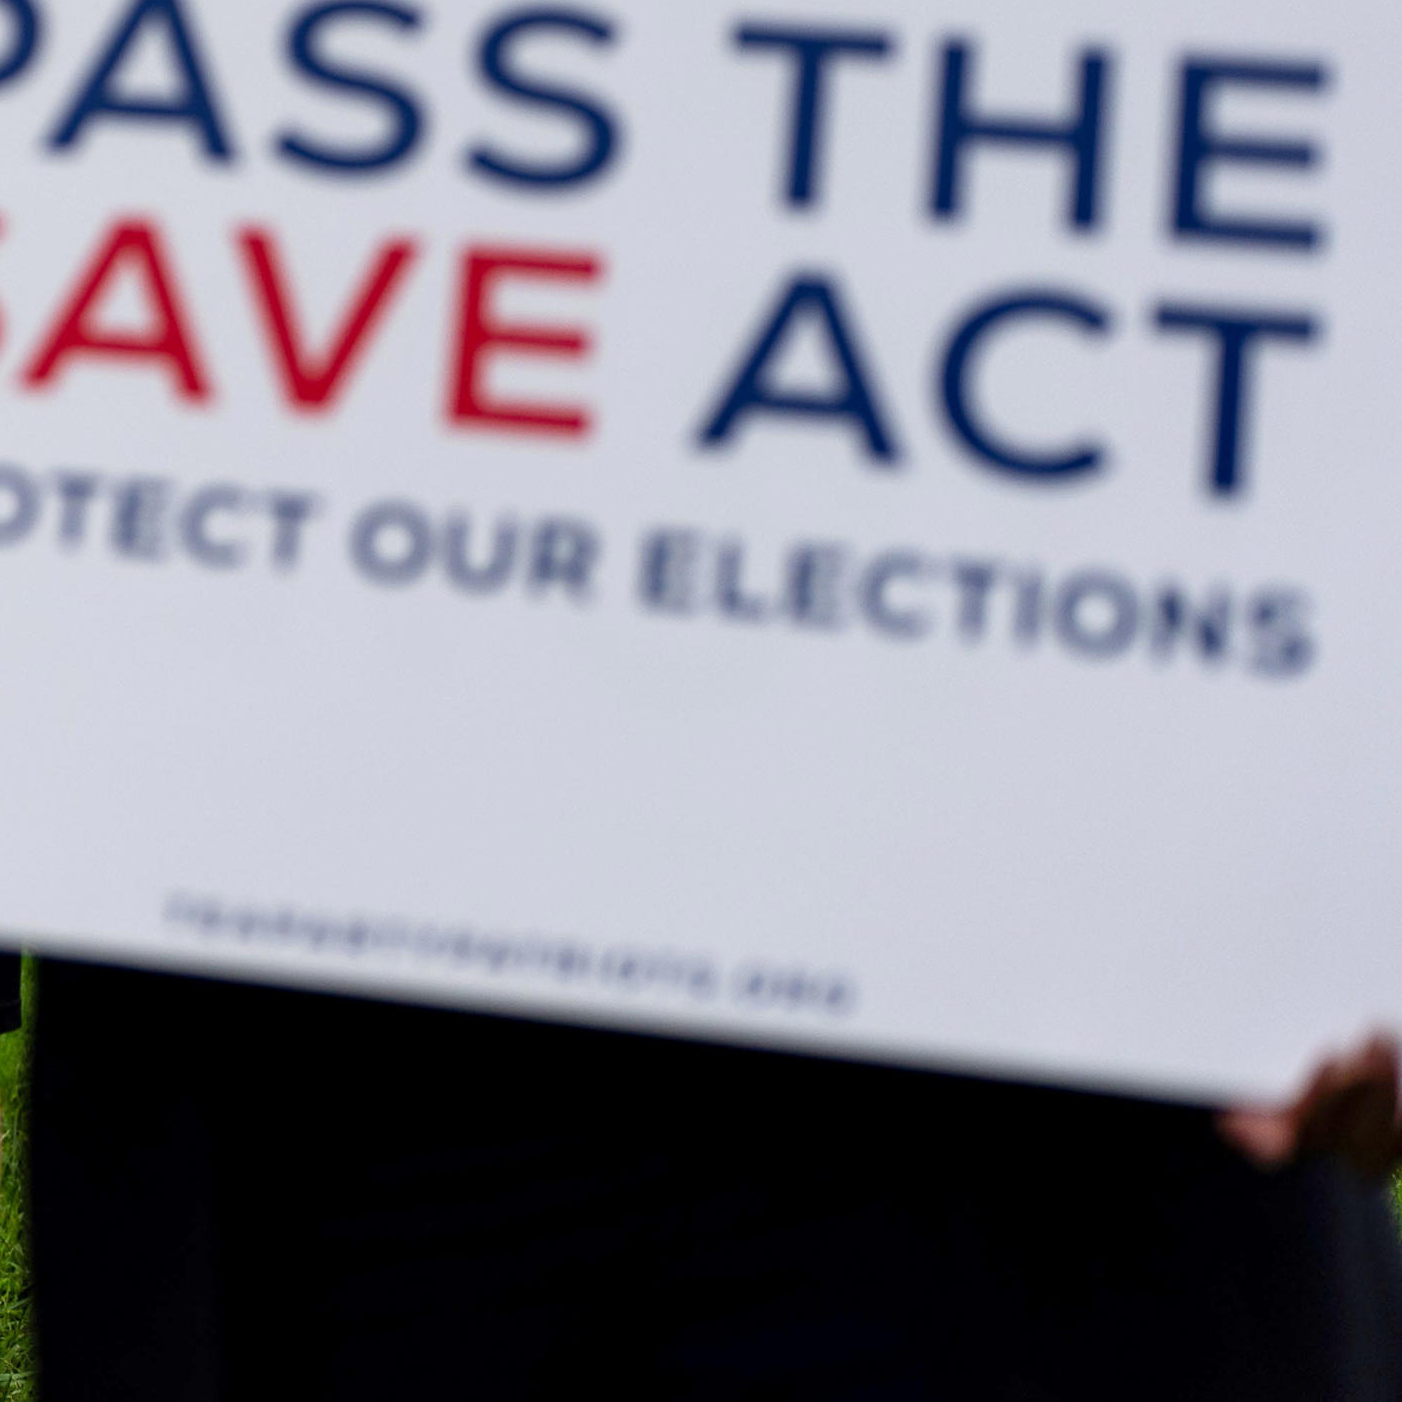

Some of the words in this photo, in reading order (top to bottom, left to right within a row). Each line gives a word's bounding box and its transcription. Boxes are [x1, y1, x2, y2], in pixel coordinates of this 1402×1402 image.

[726, 17, 1335, 260] THE
[692, 267, 1326, 506] ACT
[348, 496, 598, 608] OUR
[637, 524, 1320, 681] ELECTIONS
